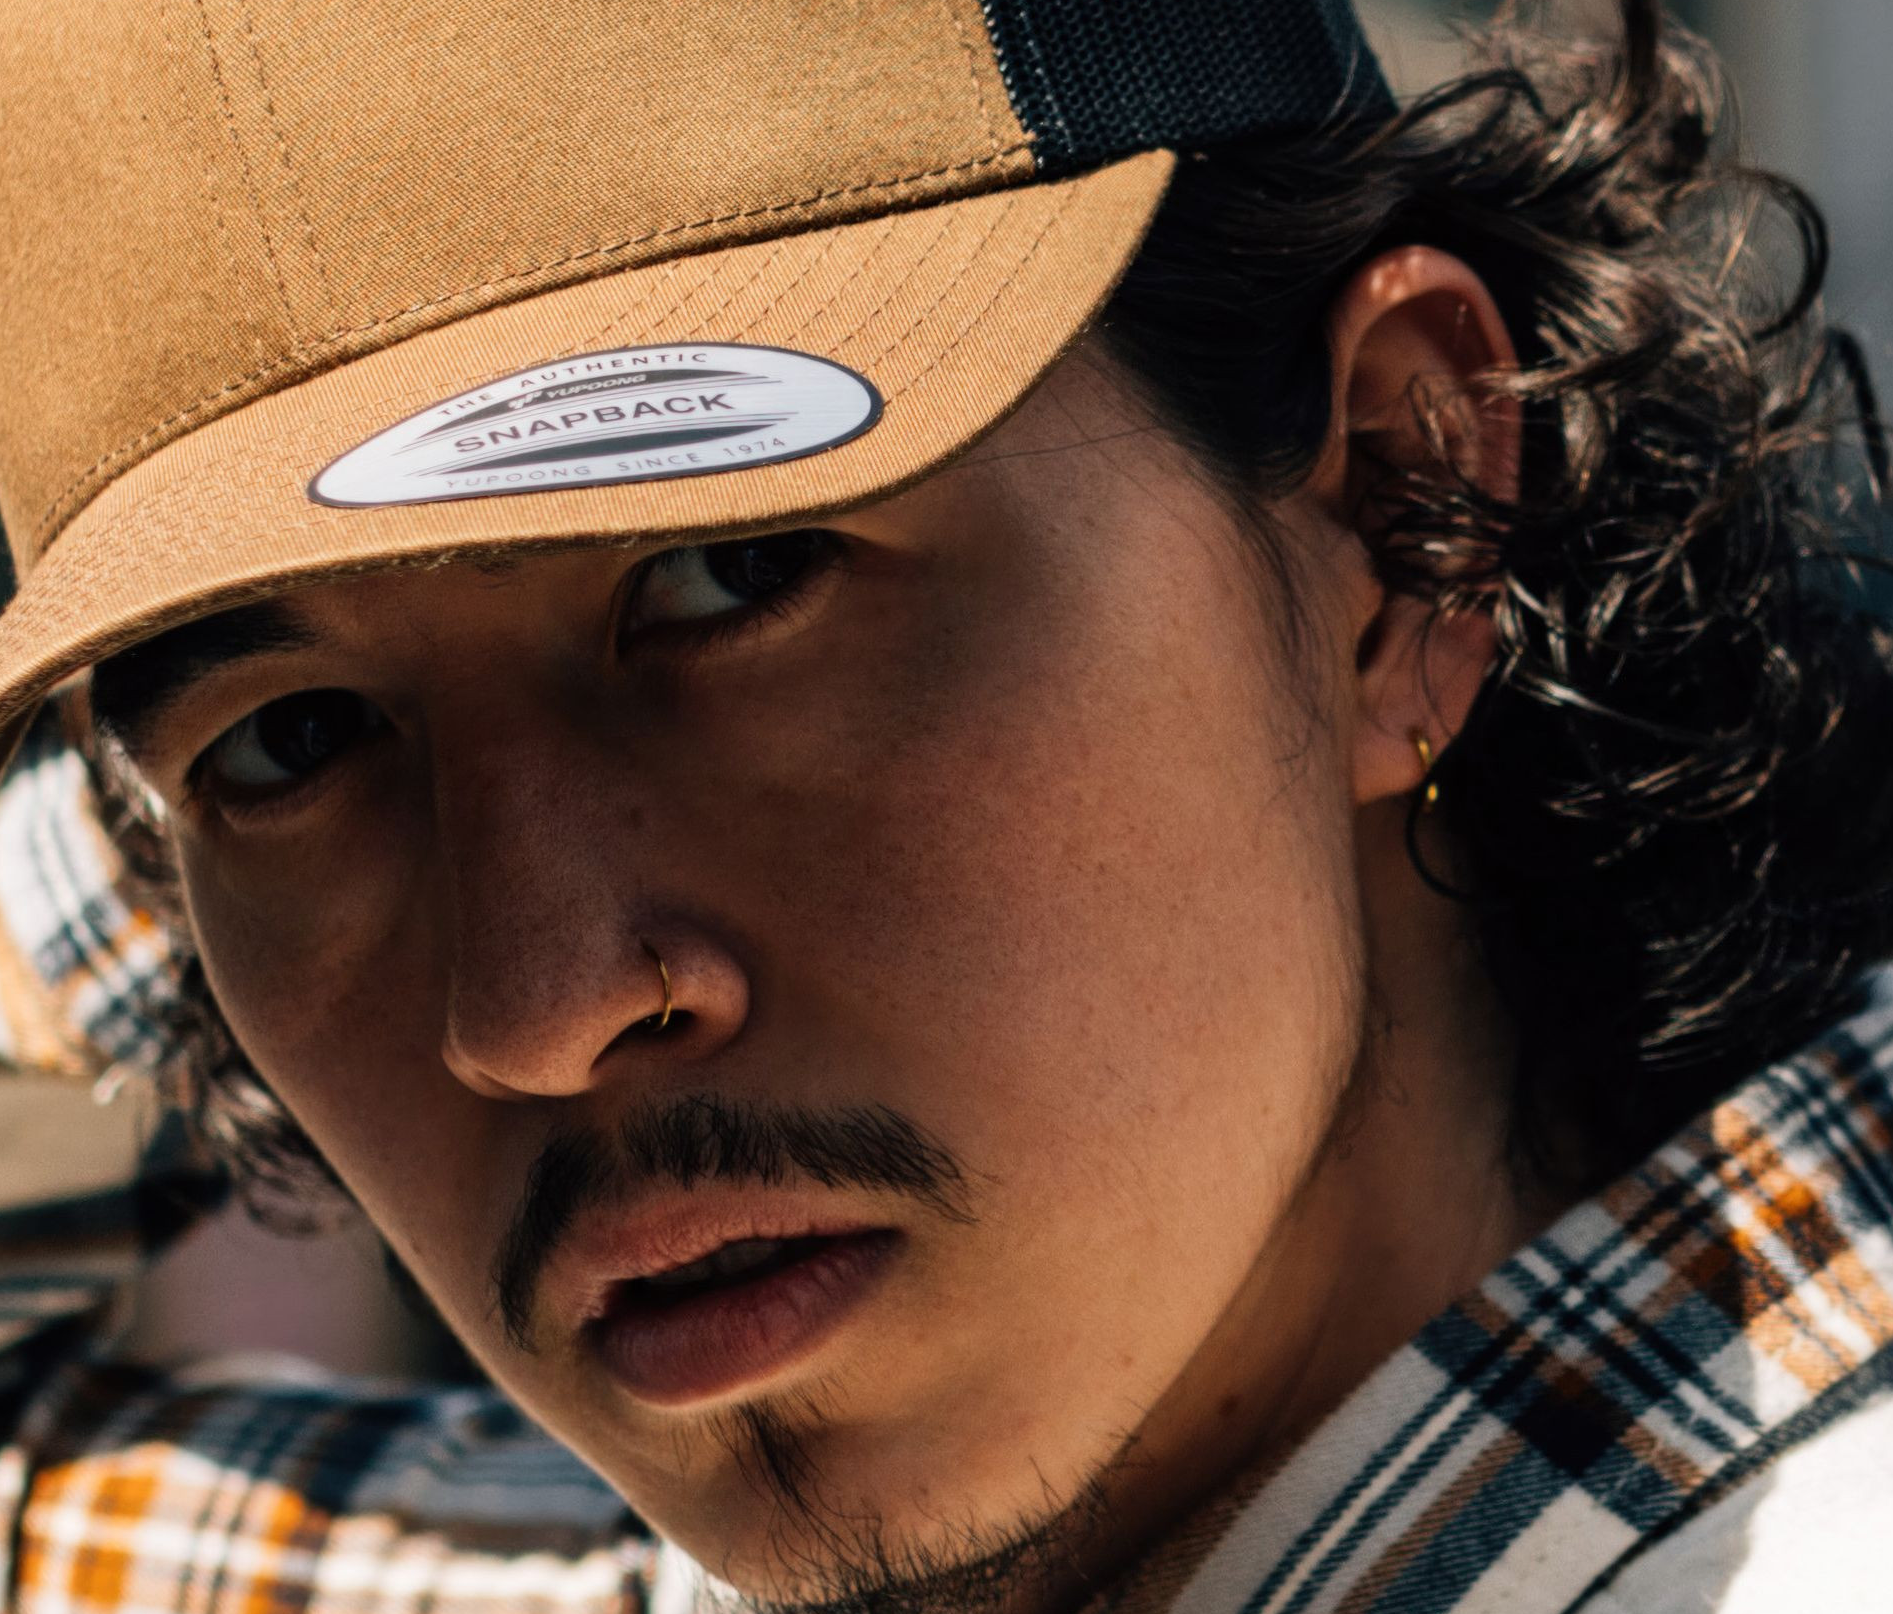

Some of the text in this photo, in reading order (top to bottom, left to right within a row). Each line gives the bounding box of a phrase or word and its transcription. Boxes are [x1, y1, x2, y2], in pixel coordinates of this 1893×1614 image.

[437, 353, 707, 416] THE AUTHENTIC
[546, 373, 647, 400] YUPOONG
[453, 393, 735, 453] SNAPBACK
[446, 437, 787, 488] YUPOONG SINCE 1974
